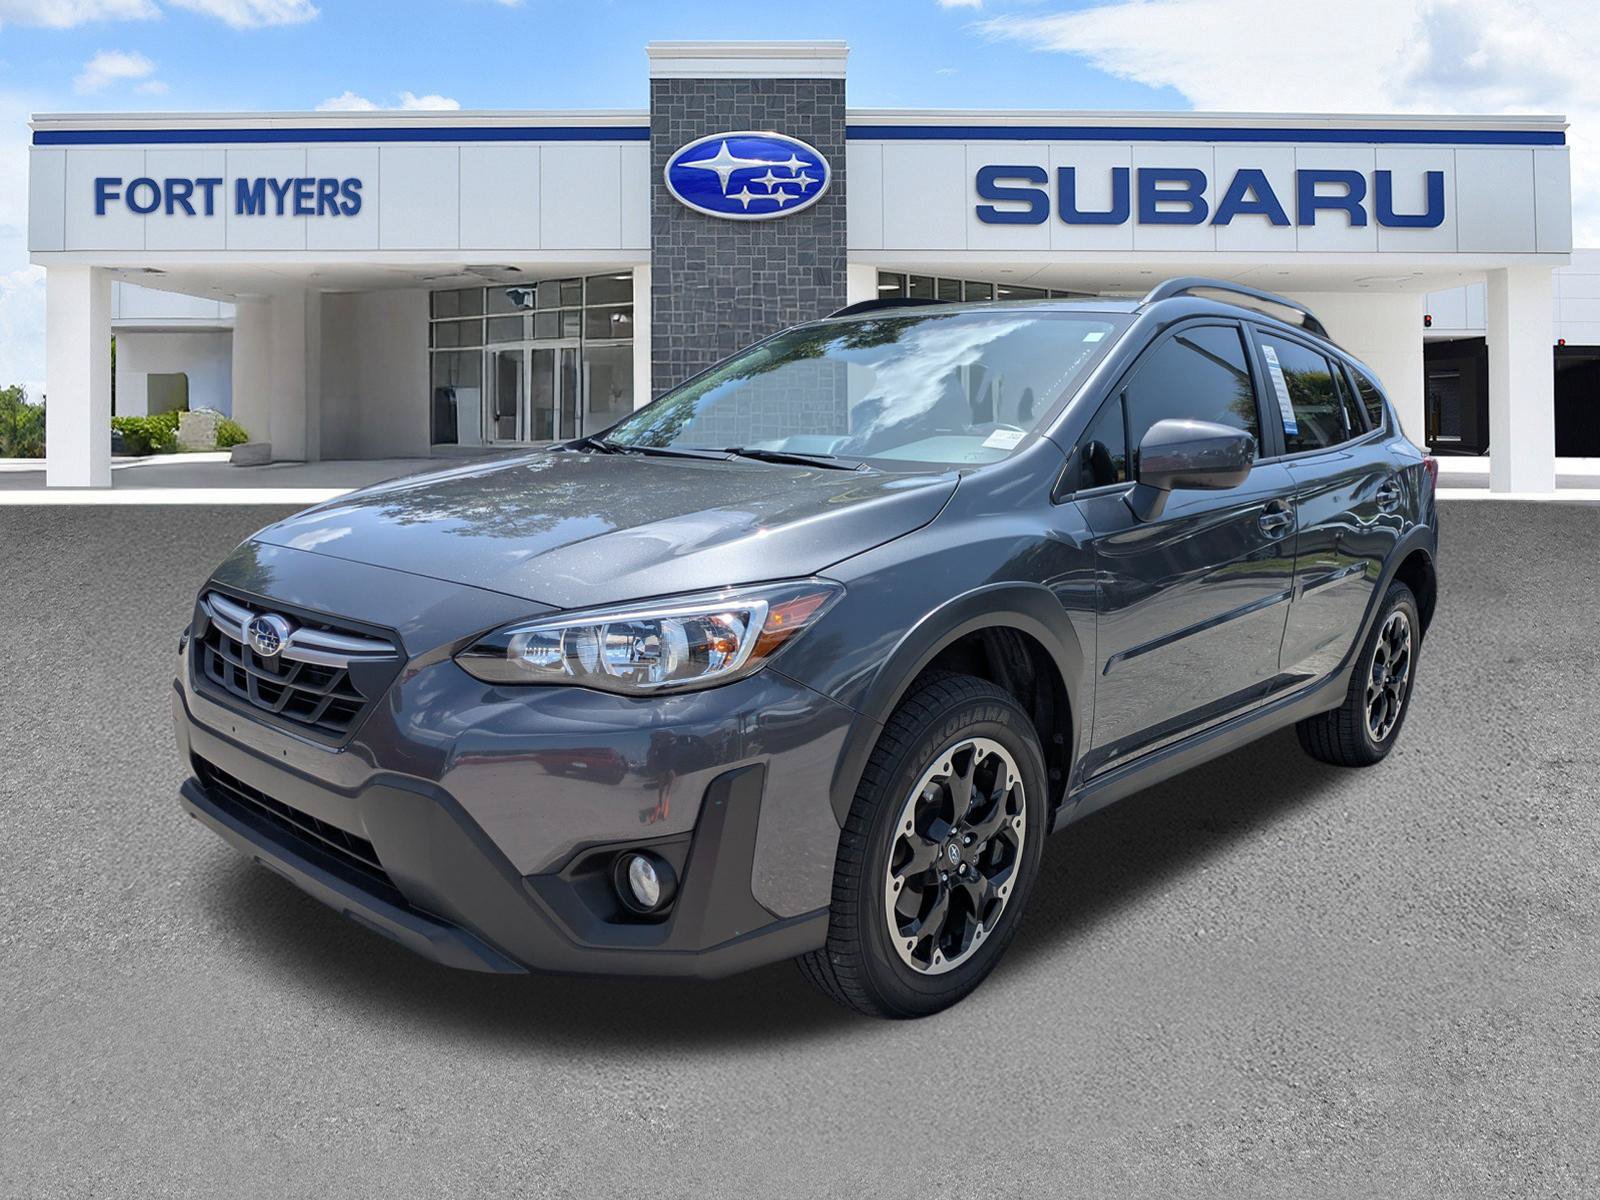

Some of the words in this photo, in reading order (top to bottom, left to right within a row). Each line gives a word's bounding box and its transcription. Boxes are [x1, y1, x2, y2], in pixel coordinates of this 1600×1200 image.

[94, 177, 223, 216] FORT
[235, 177, 363, 217] MYERS
[975, 164, 1446, 228] SUBARU
